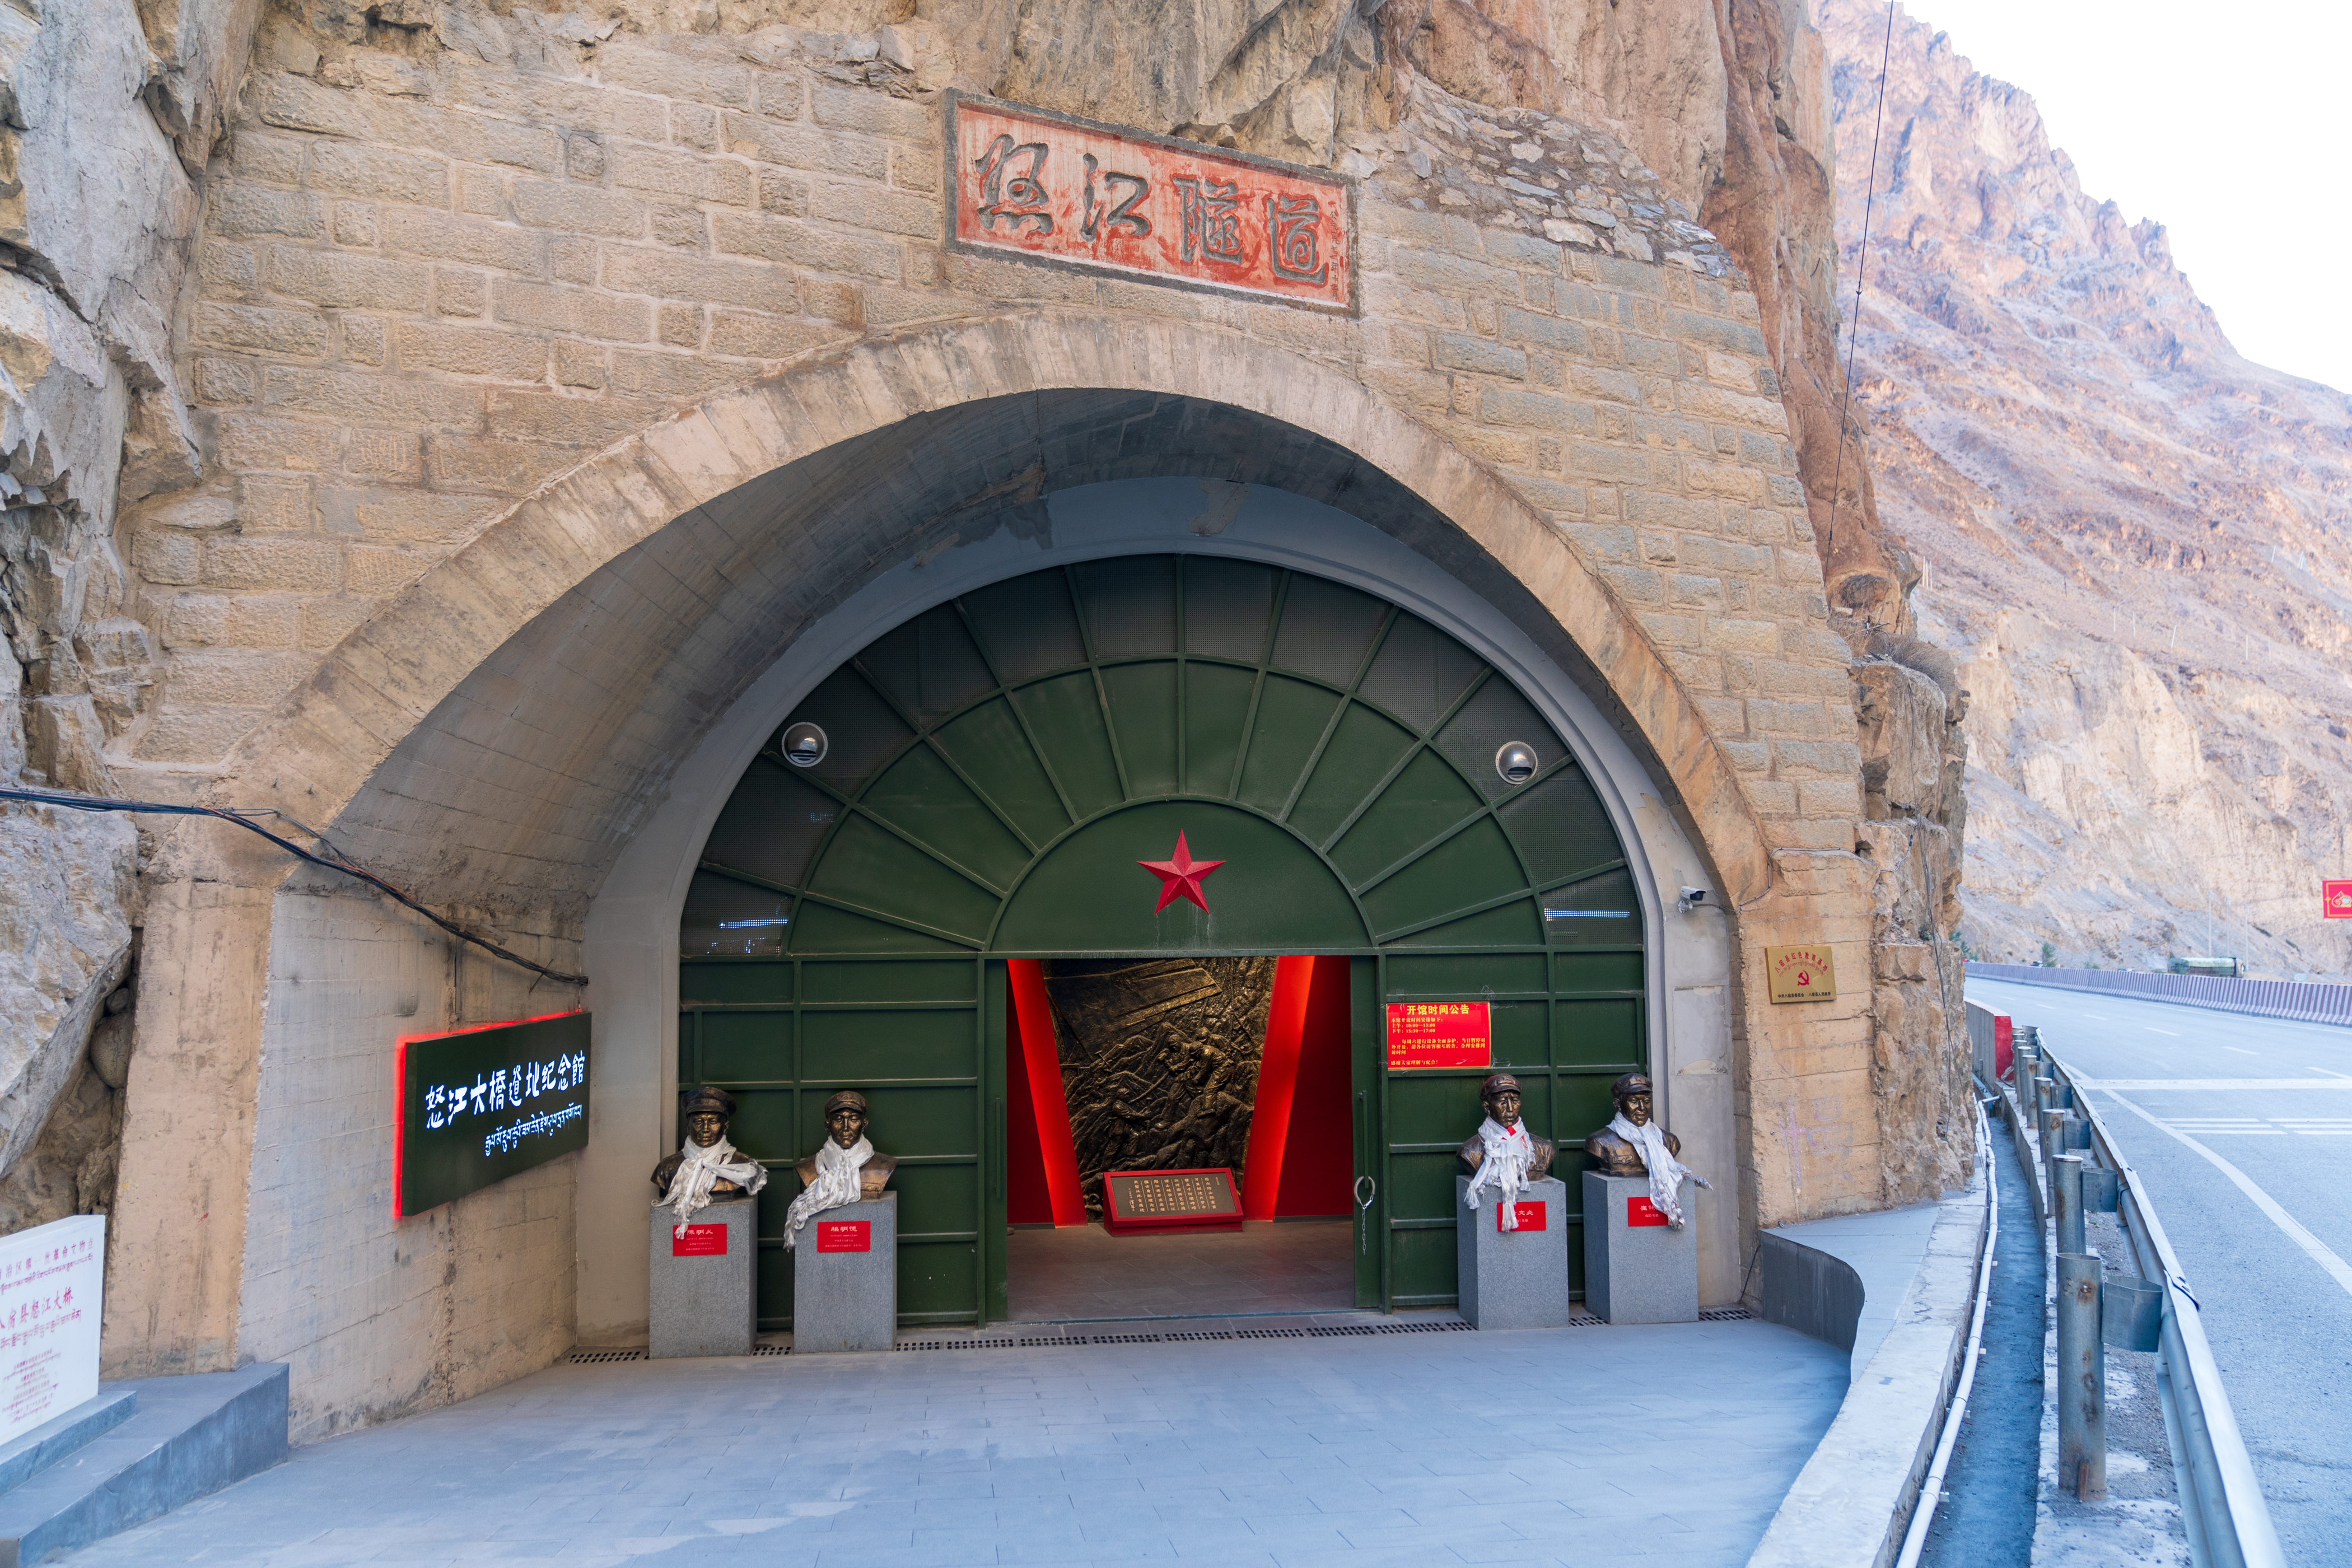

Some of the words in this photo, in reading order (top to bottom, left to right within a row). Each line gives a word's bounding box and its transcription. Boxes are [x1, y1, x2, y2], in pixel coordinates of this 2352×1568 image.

[975, 133, 1326, 284] 怒江隧道
[1406, 1005, 1469, 1015] 开馆时间公告
[0, 1237, 94, 1280] 治区第一批革命文物点
